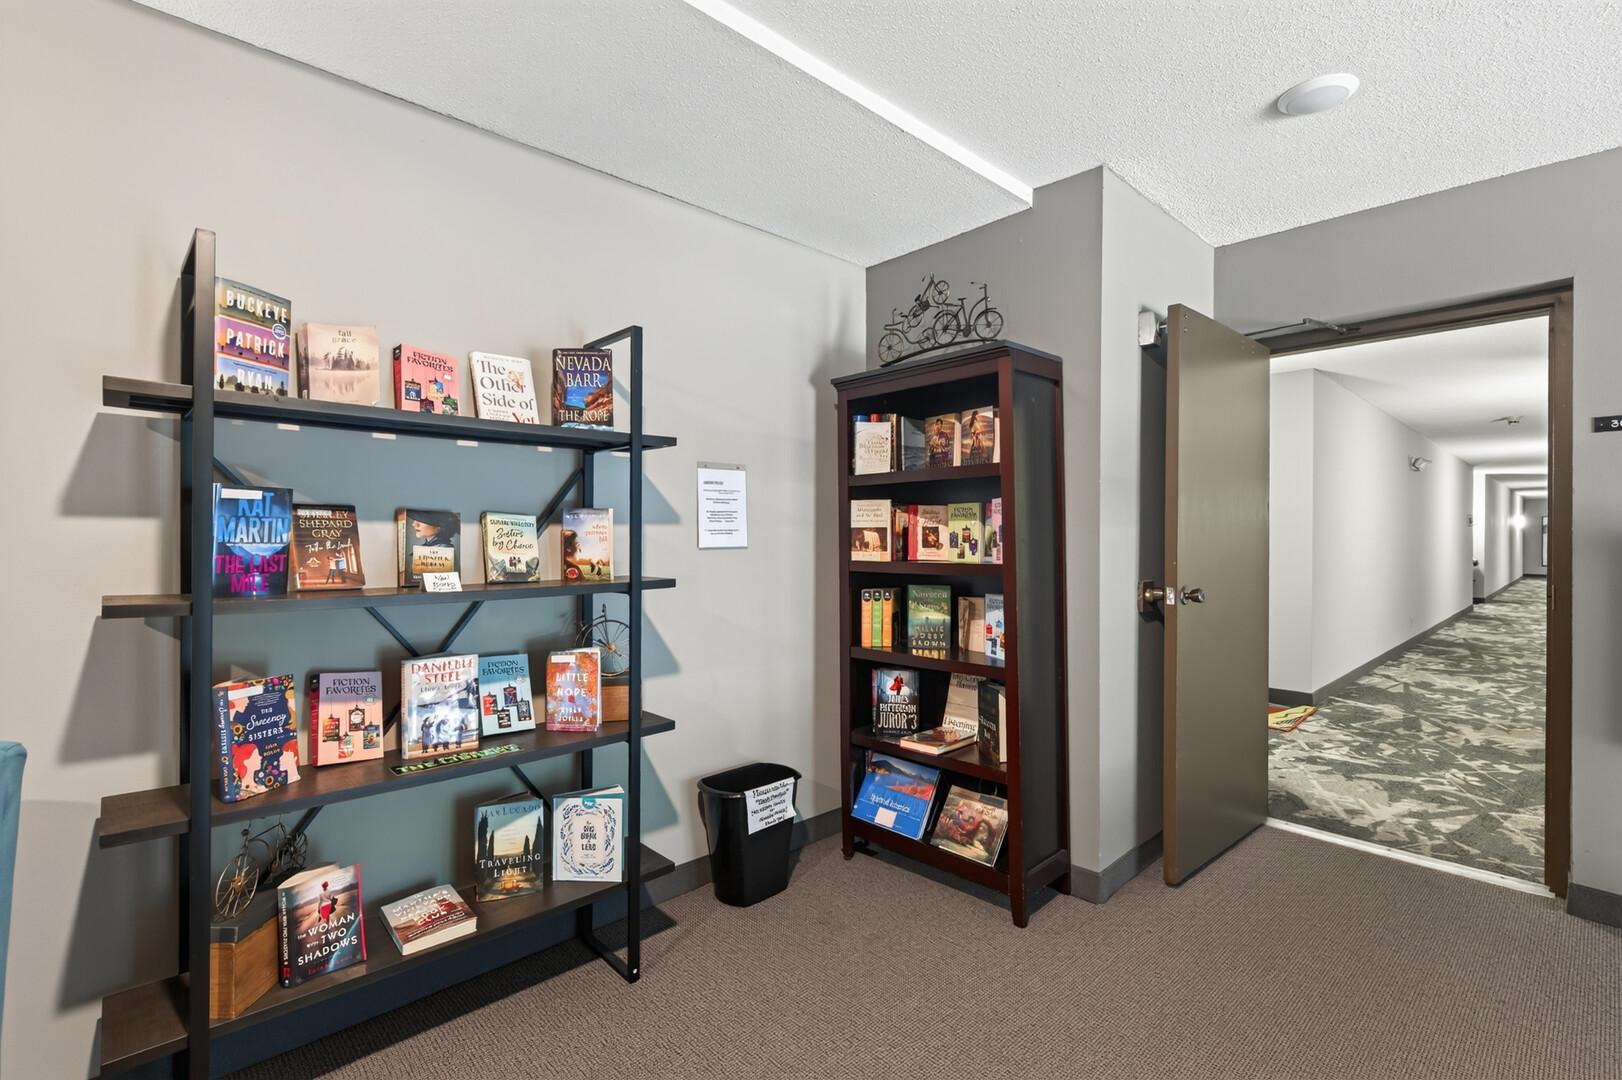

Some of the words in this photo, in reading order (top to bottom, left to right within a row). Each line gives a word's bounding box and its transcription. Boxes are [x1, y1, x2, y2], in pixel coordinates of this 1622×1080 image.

[225, 289, 288, 324] BUCKEYE
[226, 328, 286, 359] PATRICK
[406, 356, 454, 373] FAVORITES
[413, 351, 448, 365] FICTION
[555, 356, 612, 372] NEVADA
[476, 360, 506, 375] The
[236, 368, 274, 390] RYAN
[480, 376, 526, 394] Other
[566, 372, 602, 388] BARR
[481, 392, 516, 409] Side
[519, 398, 535, 411] of
[559, 409, 581, 422] THE
[582, 410, 610, 422] ROPE
[1611, 419, 1622, 428] 3
[238, 491, 275, 517] KAT
[217, 516, 289, 543] MARTIN
[299, 519, 353, 528] SHEPARD
[311, 528, 343, 539] GRAY
[492, 536, 504, 550] by
[214, 554, 246, 574] THE
[248, 554, 287, 573] LAST
[230, 573, 270, 593] MILE
[411, 657, 473, 674] DANIELLE
[482, 666, 525, 675] FAVORITES
[488, 660, 519, 668] FICTION
[332, 677, 371, 687] FICTION
[424, 670, 462, 684] STEEL
[555, 672, 589, 682] LITTLE
[325, 685, 377, 696] FAVORITES
[888, 694, 909, 704] JAMES
[879, 703, 917, 713] PATTERSON
[877, 711, 908, 729] JUROR
[248, 727, 284, 742] SISTERS
[479, 852, 541, 869] TRAVELING
[494, 865, 527, 878] LIGHT
[308, 912, 355, 937] WOMAN
[320, 927, 347, 944] TWO
[297, 935, 358, 966] SHADOWS
